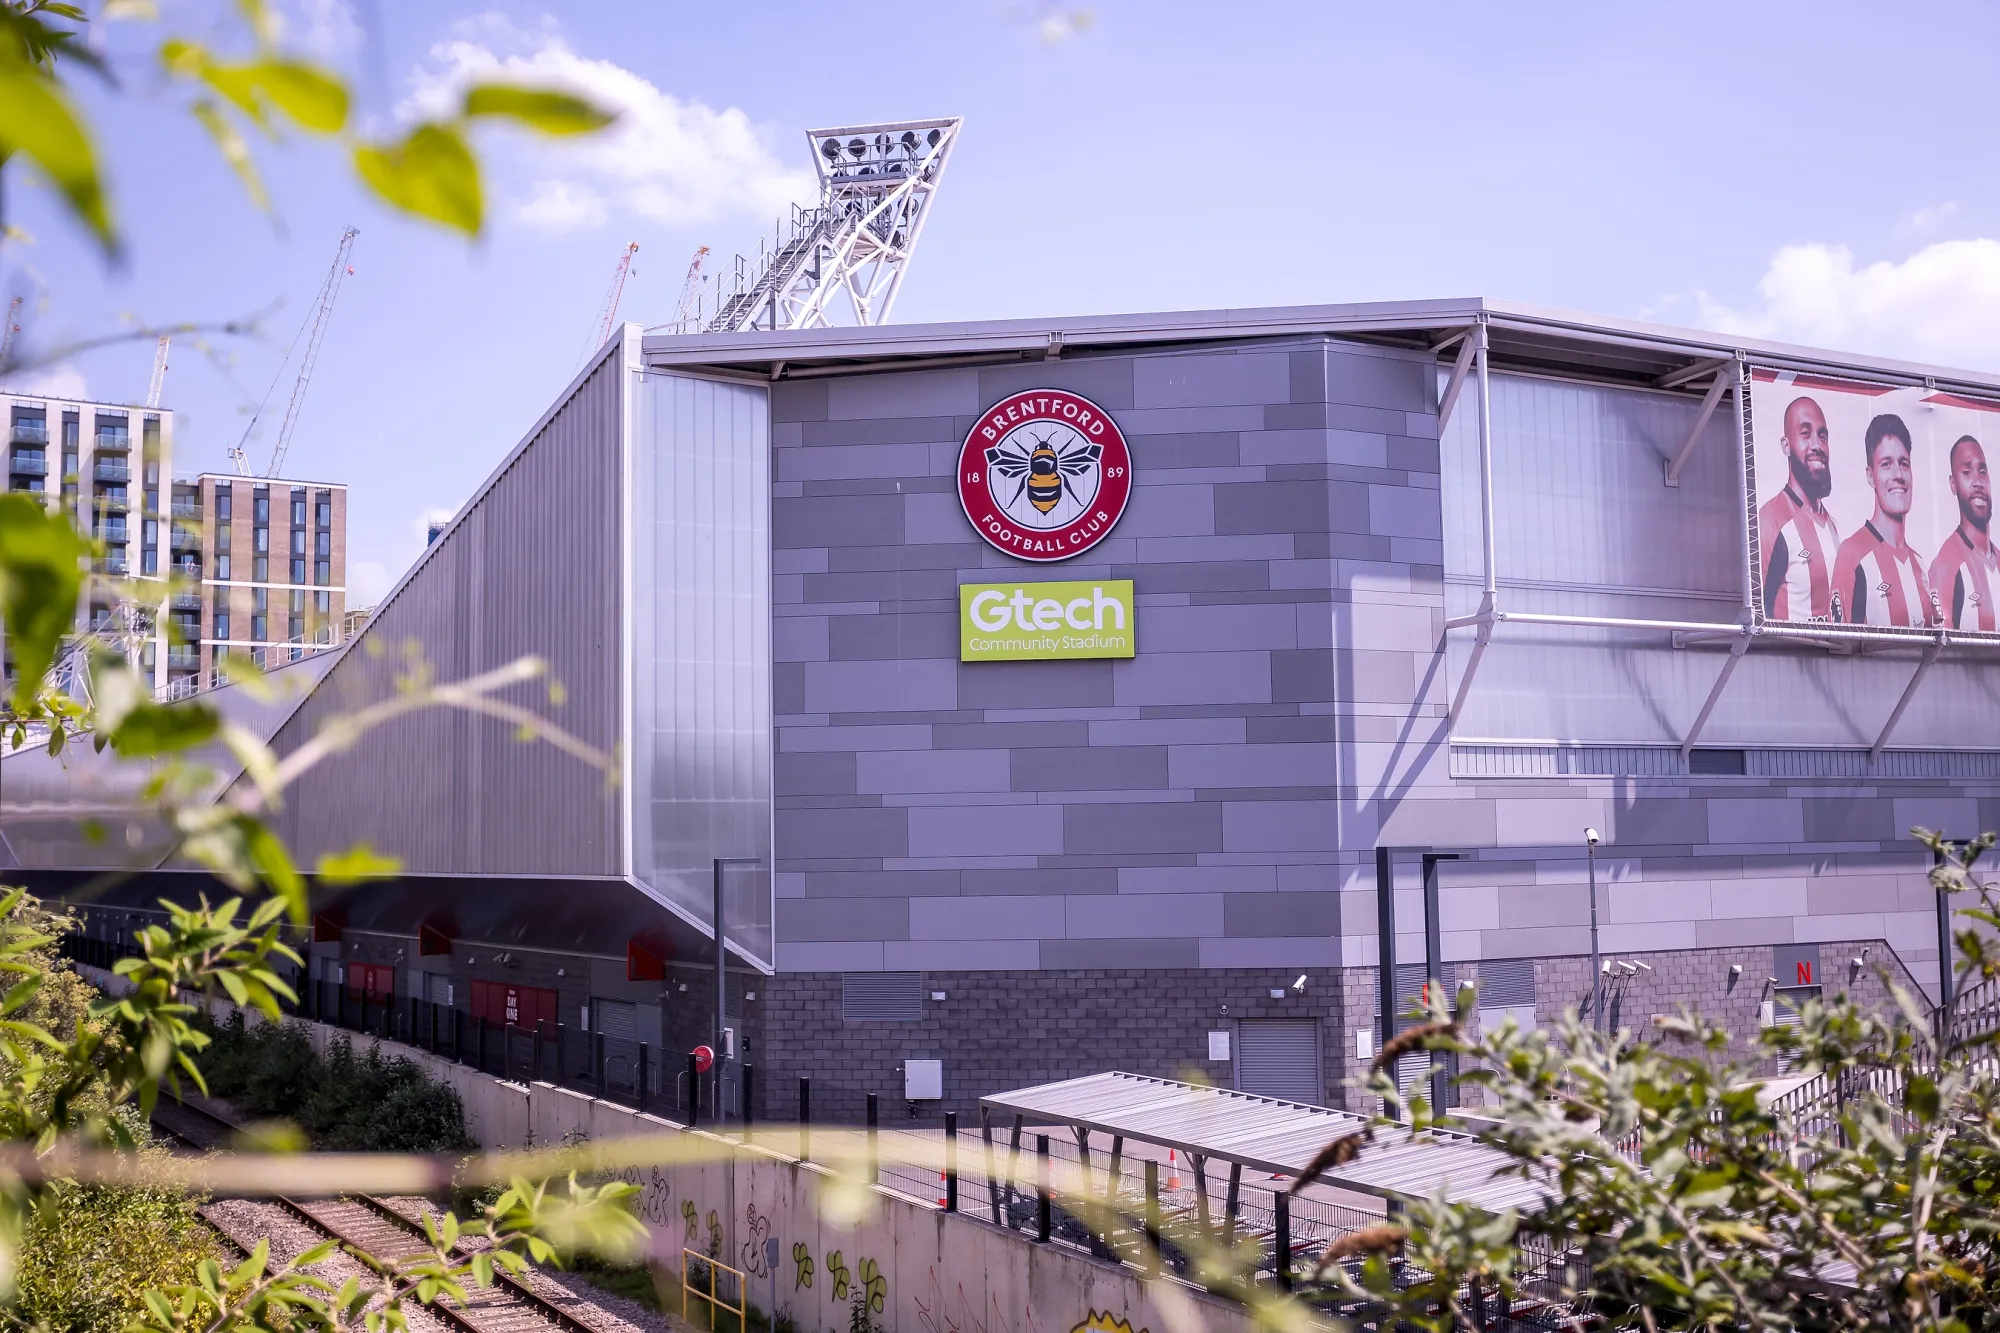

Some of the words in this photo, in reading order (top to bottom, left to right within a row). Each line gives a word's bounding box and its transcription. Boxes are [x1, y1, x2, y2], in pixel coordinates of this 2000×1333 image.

[981, 398, 1105, 441] BRENTFORD
[966, 472, 980, 484] 18
[1107, 466, 1124, 479] 89
[982, 513, 1065, 552] FOOTBALL
[1069, 510, 1109, 545] CLUB
[969, 587, 1125, 633] Gtech
[969, 636, 1060, 653] Community
[1062, 634, 1126, 650] Stadium
[1797, 960, 1812, 985] N
